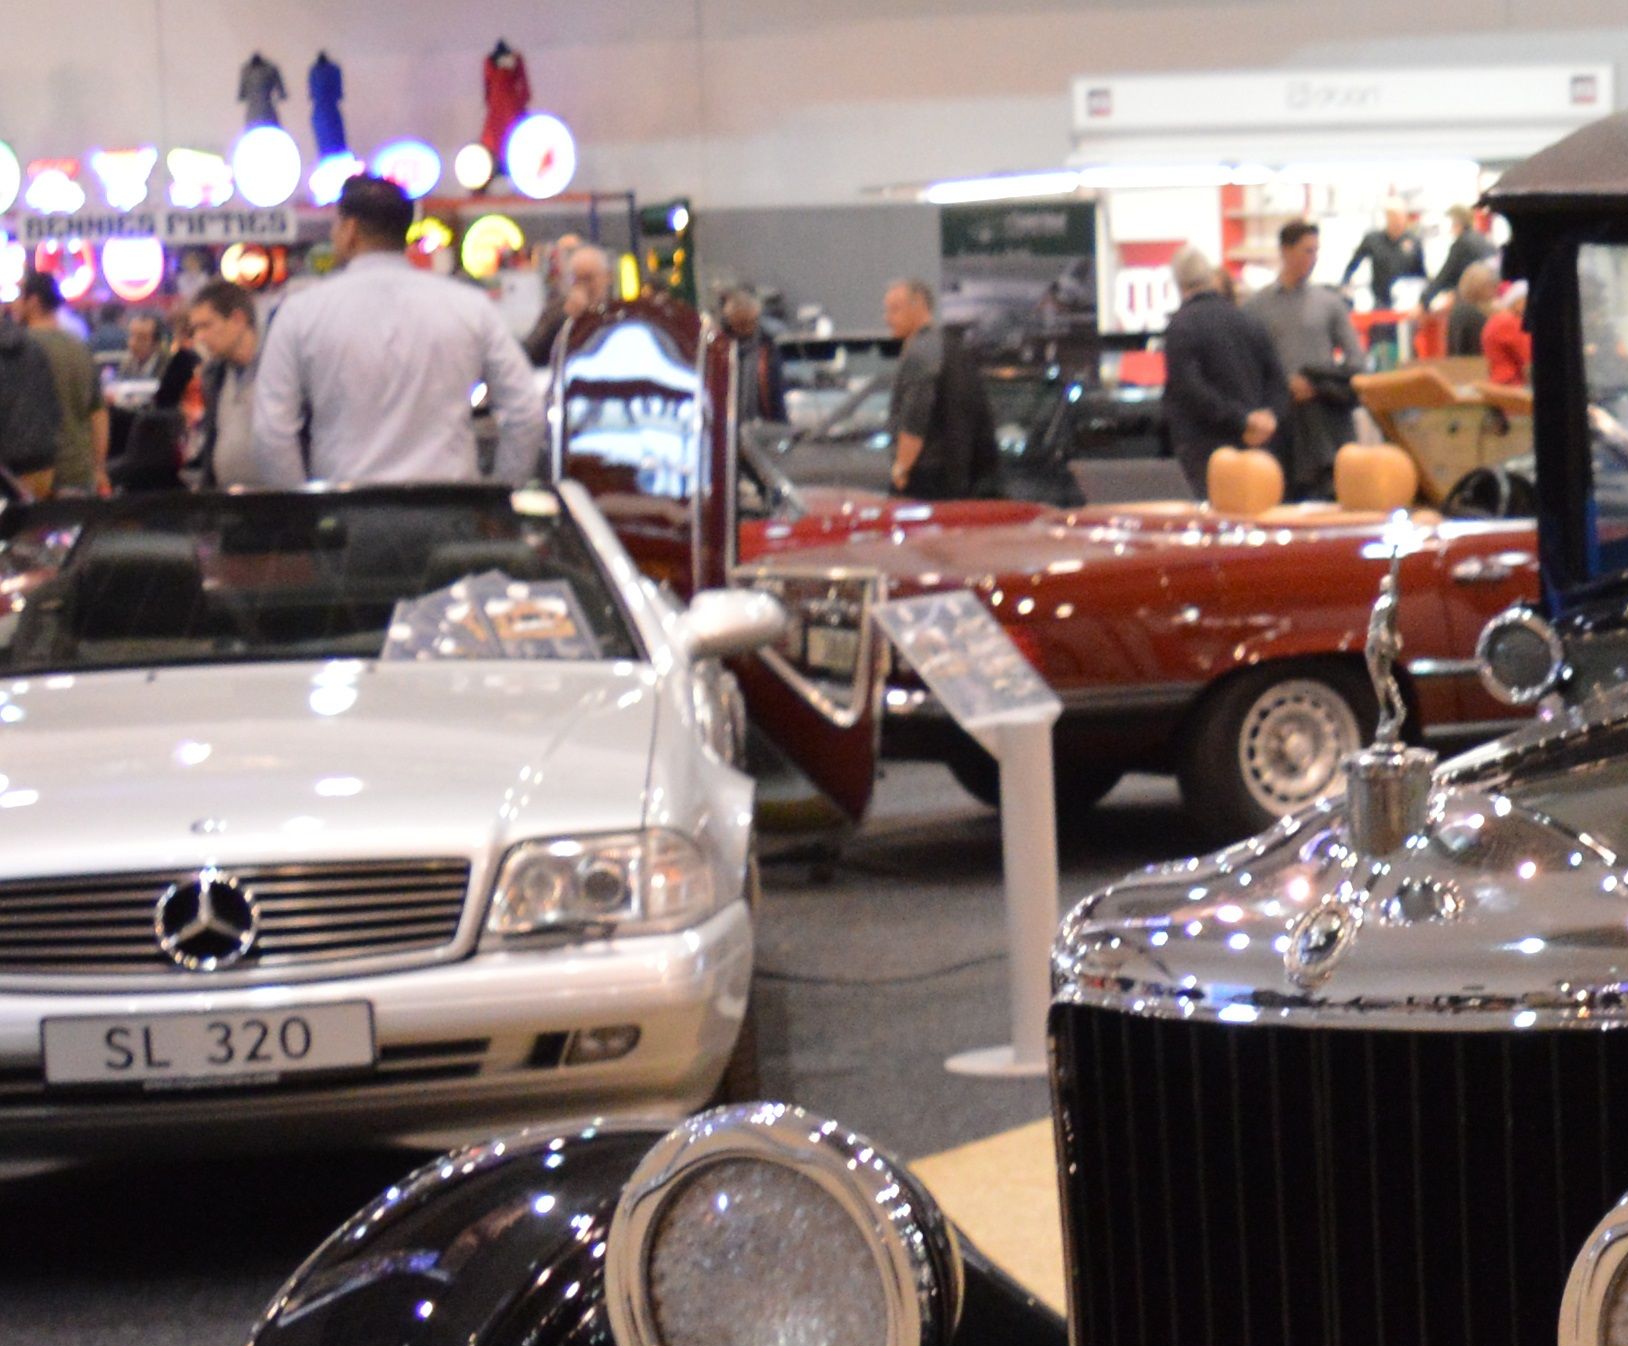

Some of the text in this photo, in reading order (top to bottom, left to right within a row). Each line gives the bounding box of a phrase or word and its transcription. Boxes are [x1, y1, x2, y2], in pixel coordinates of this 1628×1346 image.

[166, 211, 287, 235] FIFTIES
[104, 1016, 312, 1070] SL 320
